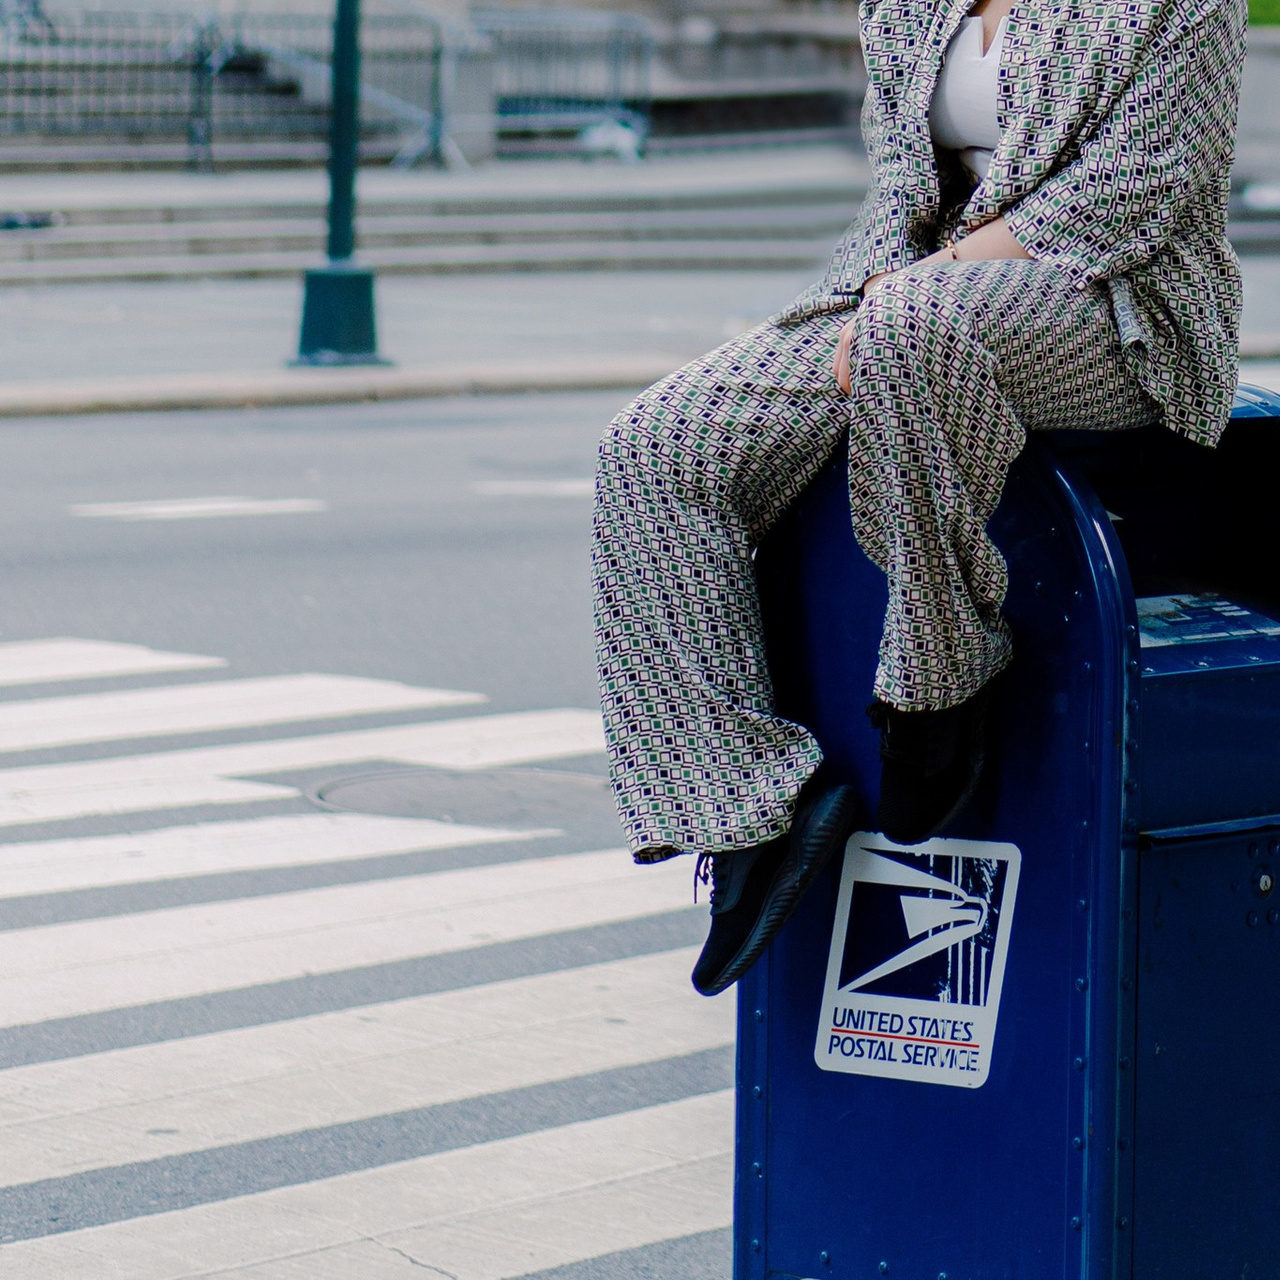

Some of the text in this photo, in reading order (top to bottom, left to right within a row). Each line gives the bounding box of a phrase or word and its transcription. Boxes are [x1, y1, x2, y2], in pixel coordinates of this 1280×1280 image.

[832, 1007, 974, 1042] UNITED STATES
[828, 1034, 898, 1062] POSTAL
